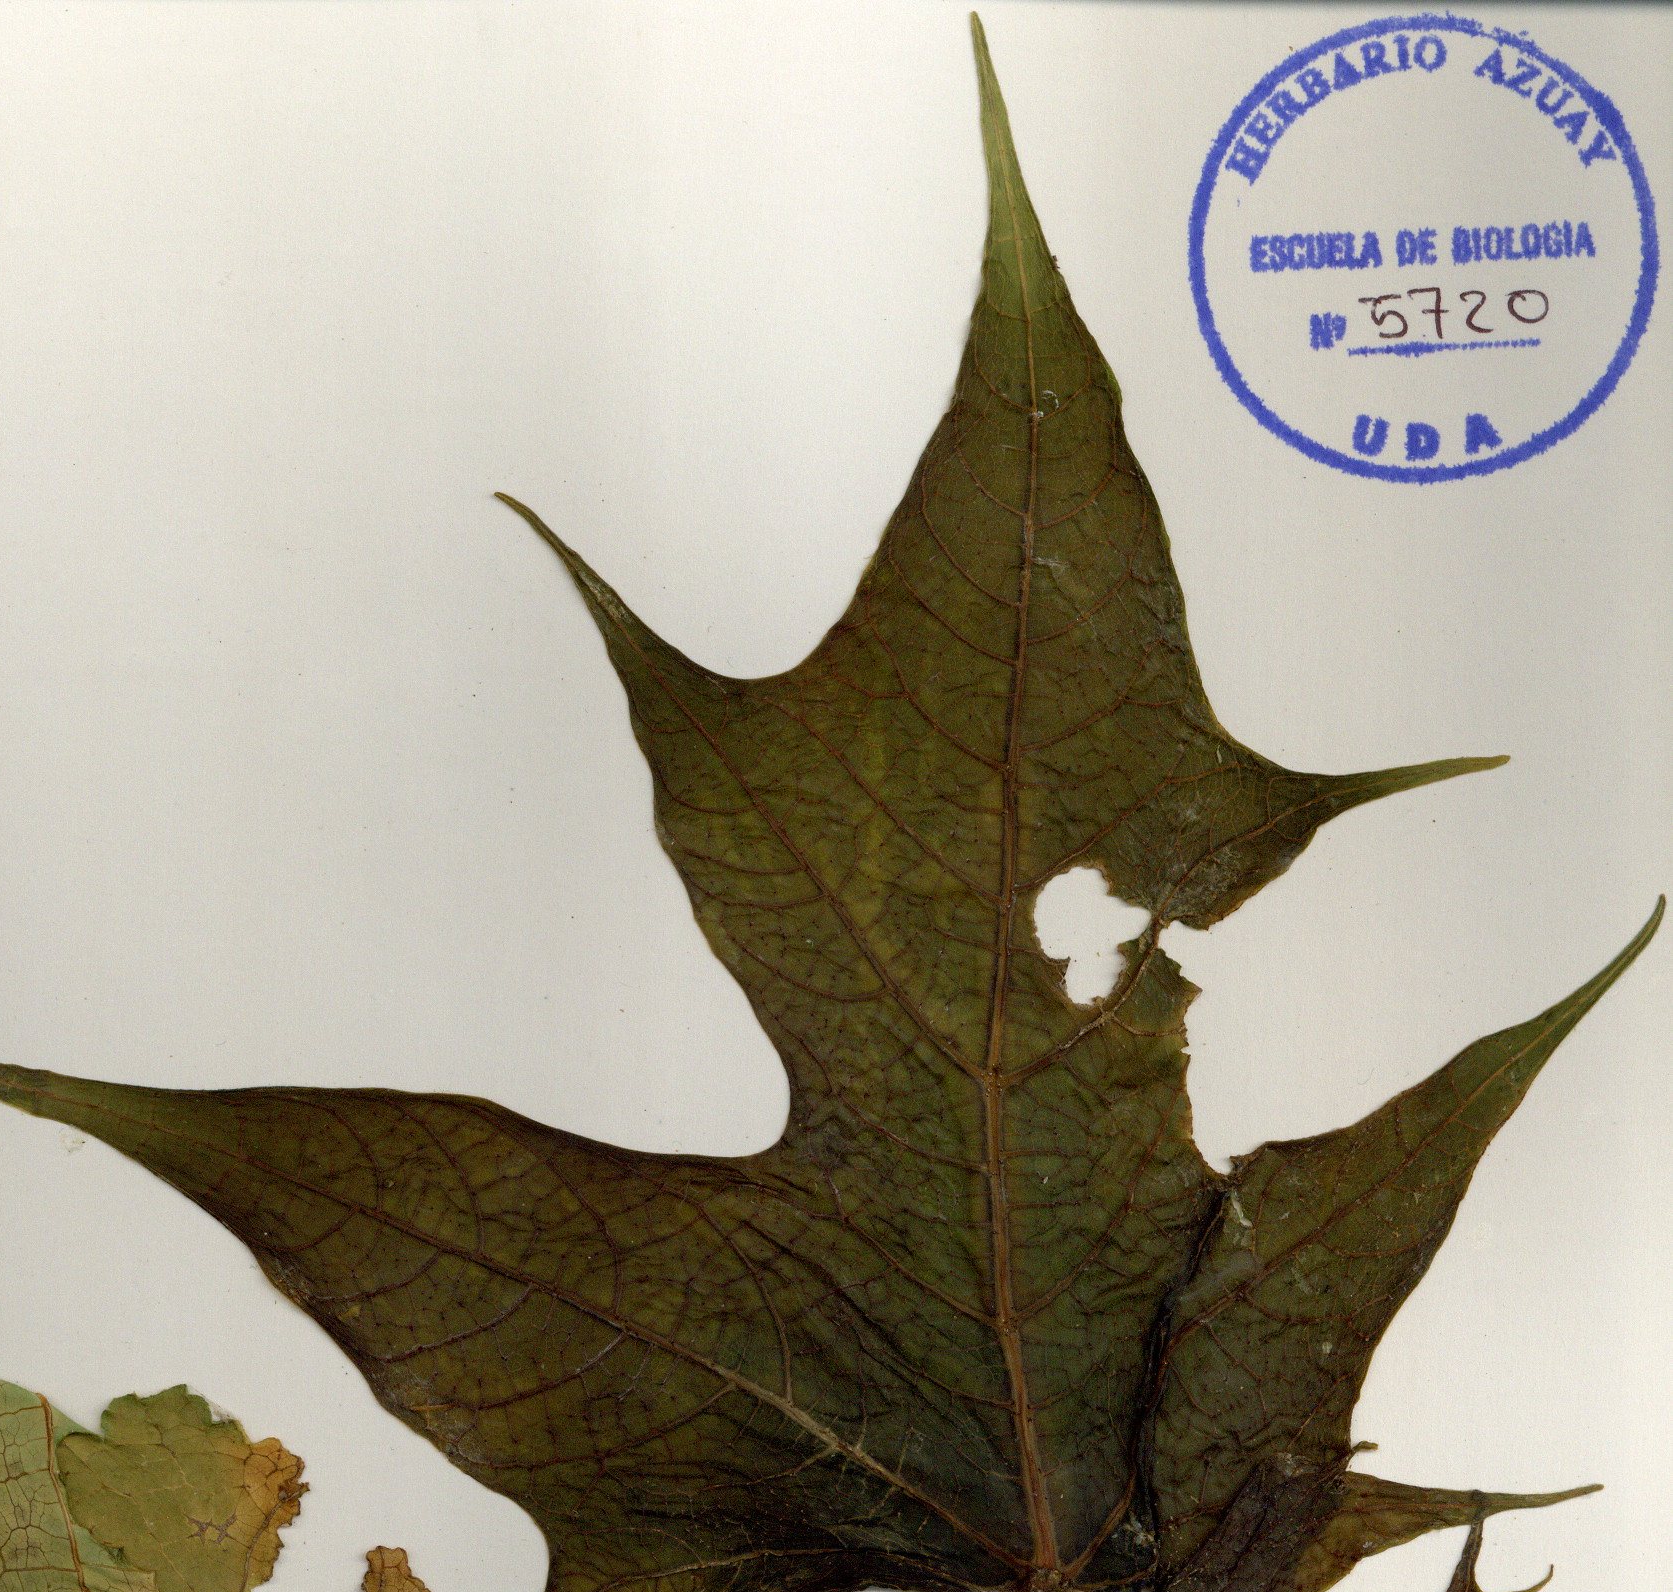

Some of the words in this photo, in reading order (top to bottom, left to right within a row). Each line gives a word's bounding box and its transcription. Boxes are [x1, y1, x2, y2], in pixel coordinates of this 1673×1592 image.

[1225, 33, 1447, 185] HERBARIO
[1475, 47, 1617, 168] AZUAY
[1250, 230, 1383, 272] ESCUELA
[1396, 227, 1438, 266] DE
[1452, 220, 1596, 264] BIOLOGIA
[1358, 287, 1549, 339] 5720
